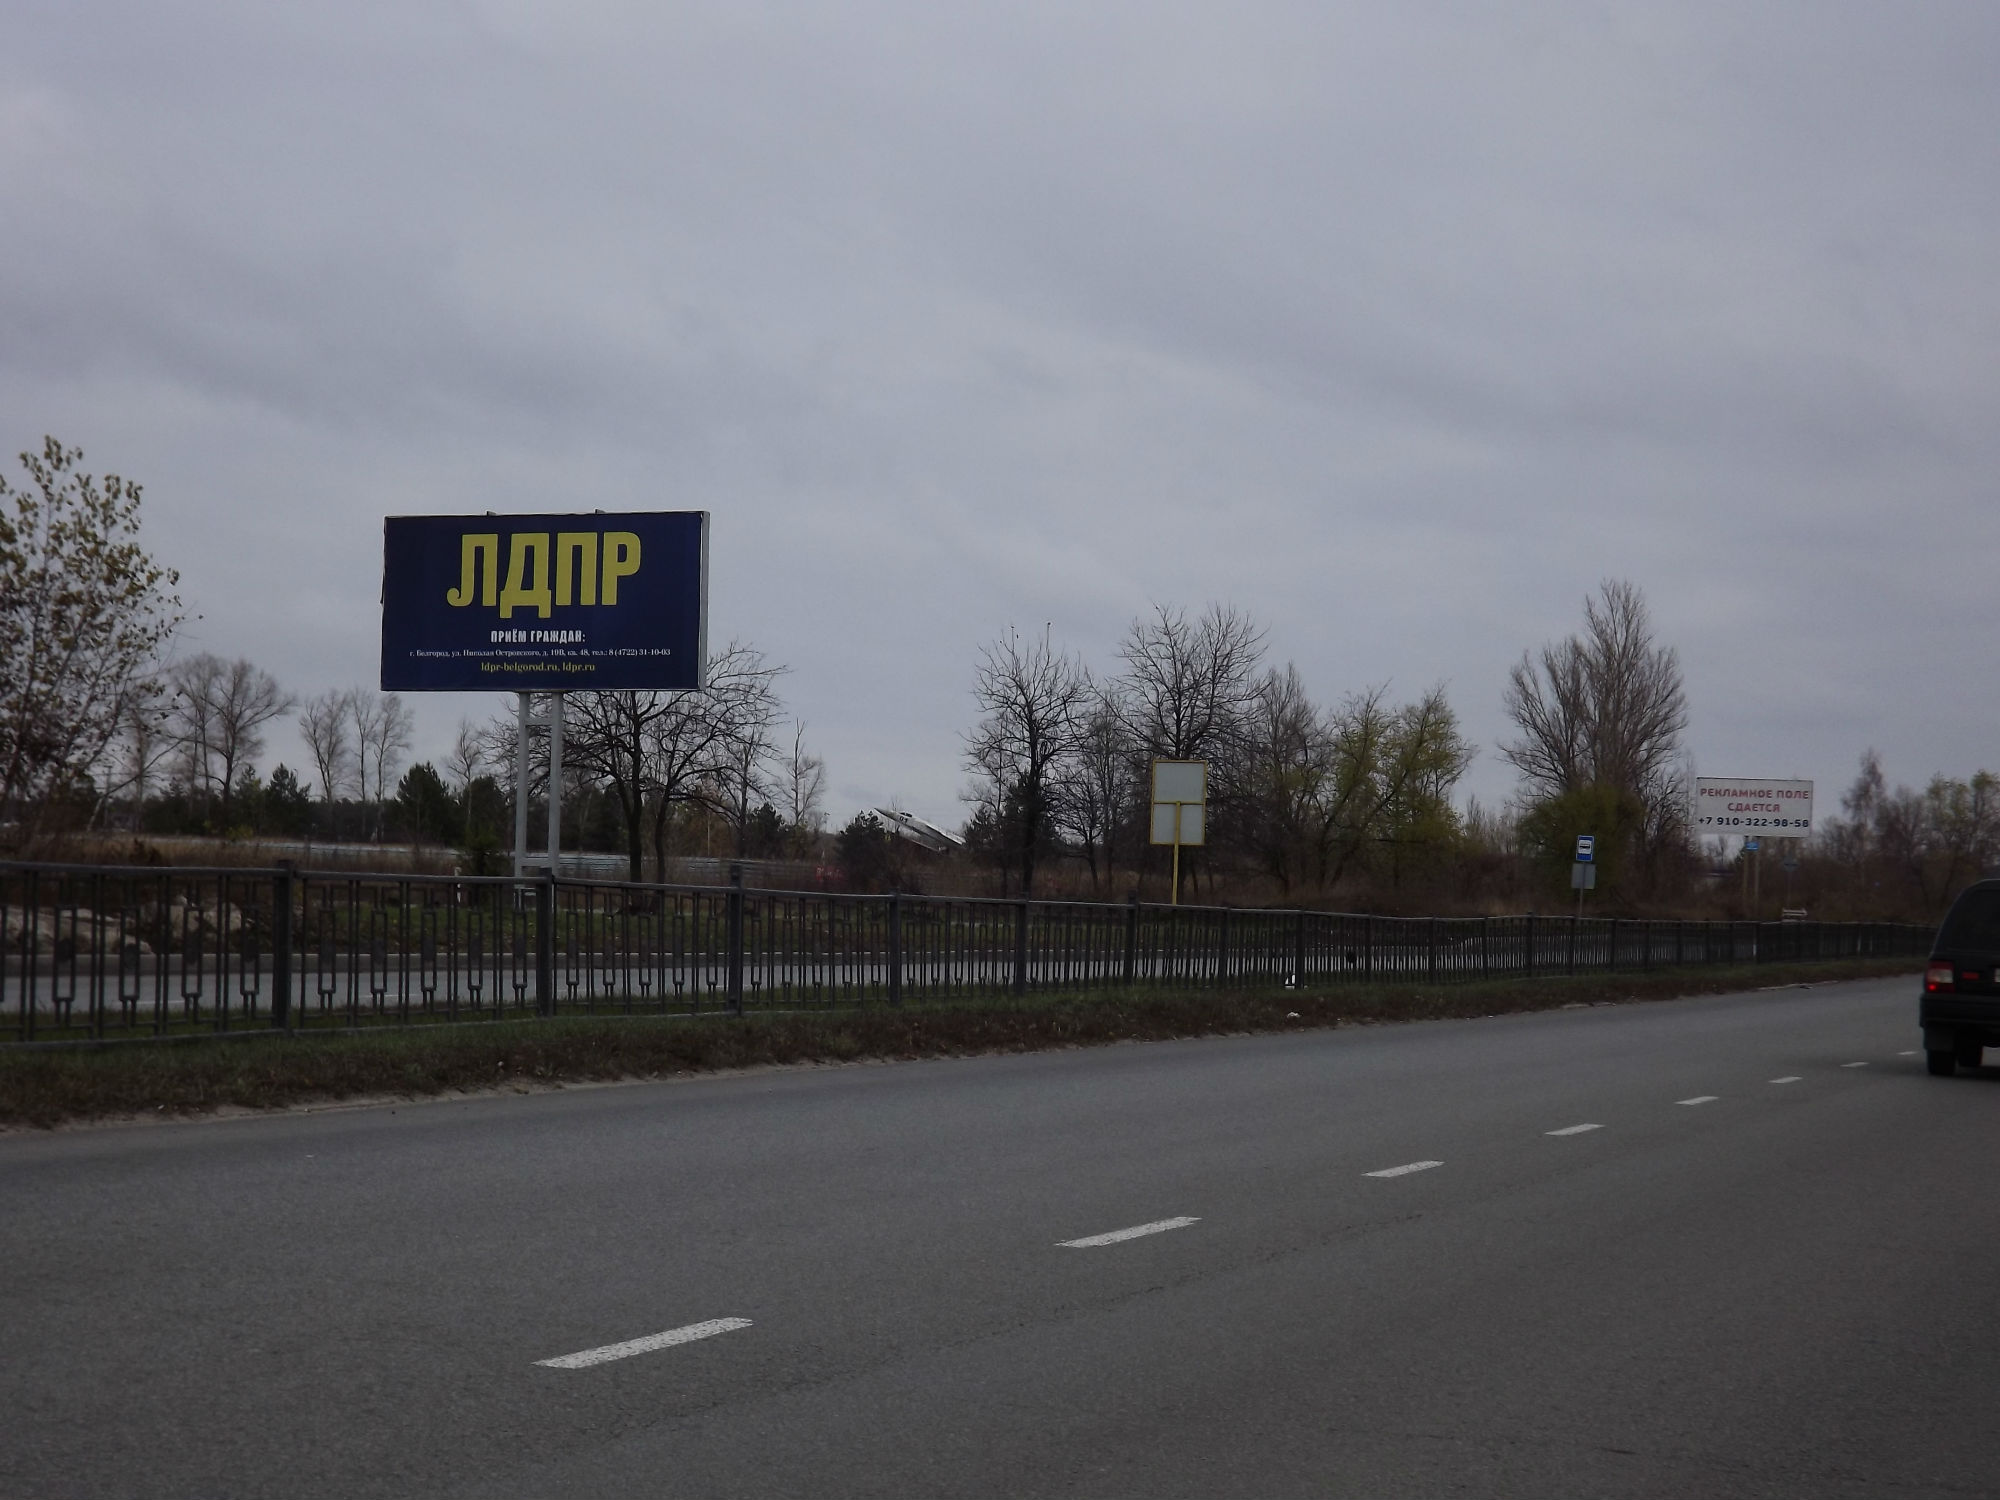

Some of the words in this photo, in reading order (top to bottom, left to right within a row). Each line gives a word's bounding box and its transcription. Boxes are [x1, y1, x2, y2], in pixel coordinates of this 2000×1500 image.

[446, 531, 641, 619] ЛДПР
[491, 629, 527, 643] ПРИЁМ
[531, 630, 586, 644] ГРАЖДАН:
[495, 649, 541, 657] Островского,
[480, 662, 559, 673] ldpr-belgorod.ru,
[563, 662, 595, 672] ldpr.ru
[1700, 788, 1772, 798] РЕКЛАМНОЕ
[1777, 790, 1809, 799] ПОЛЕ
[1728, 803, 1780, 812] СДАЕТСЯ
[1717, 817, 1809, 827] 910-322-98-58
